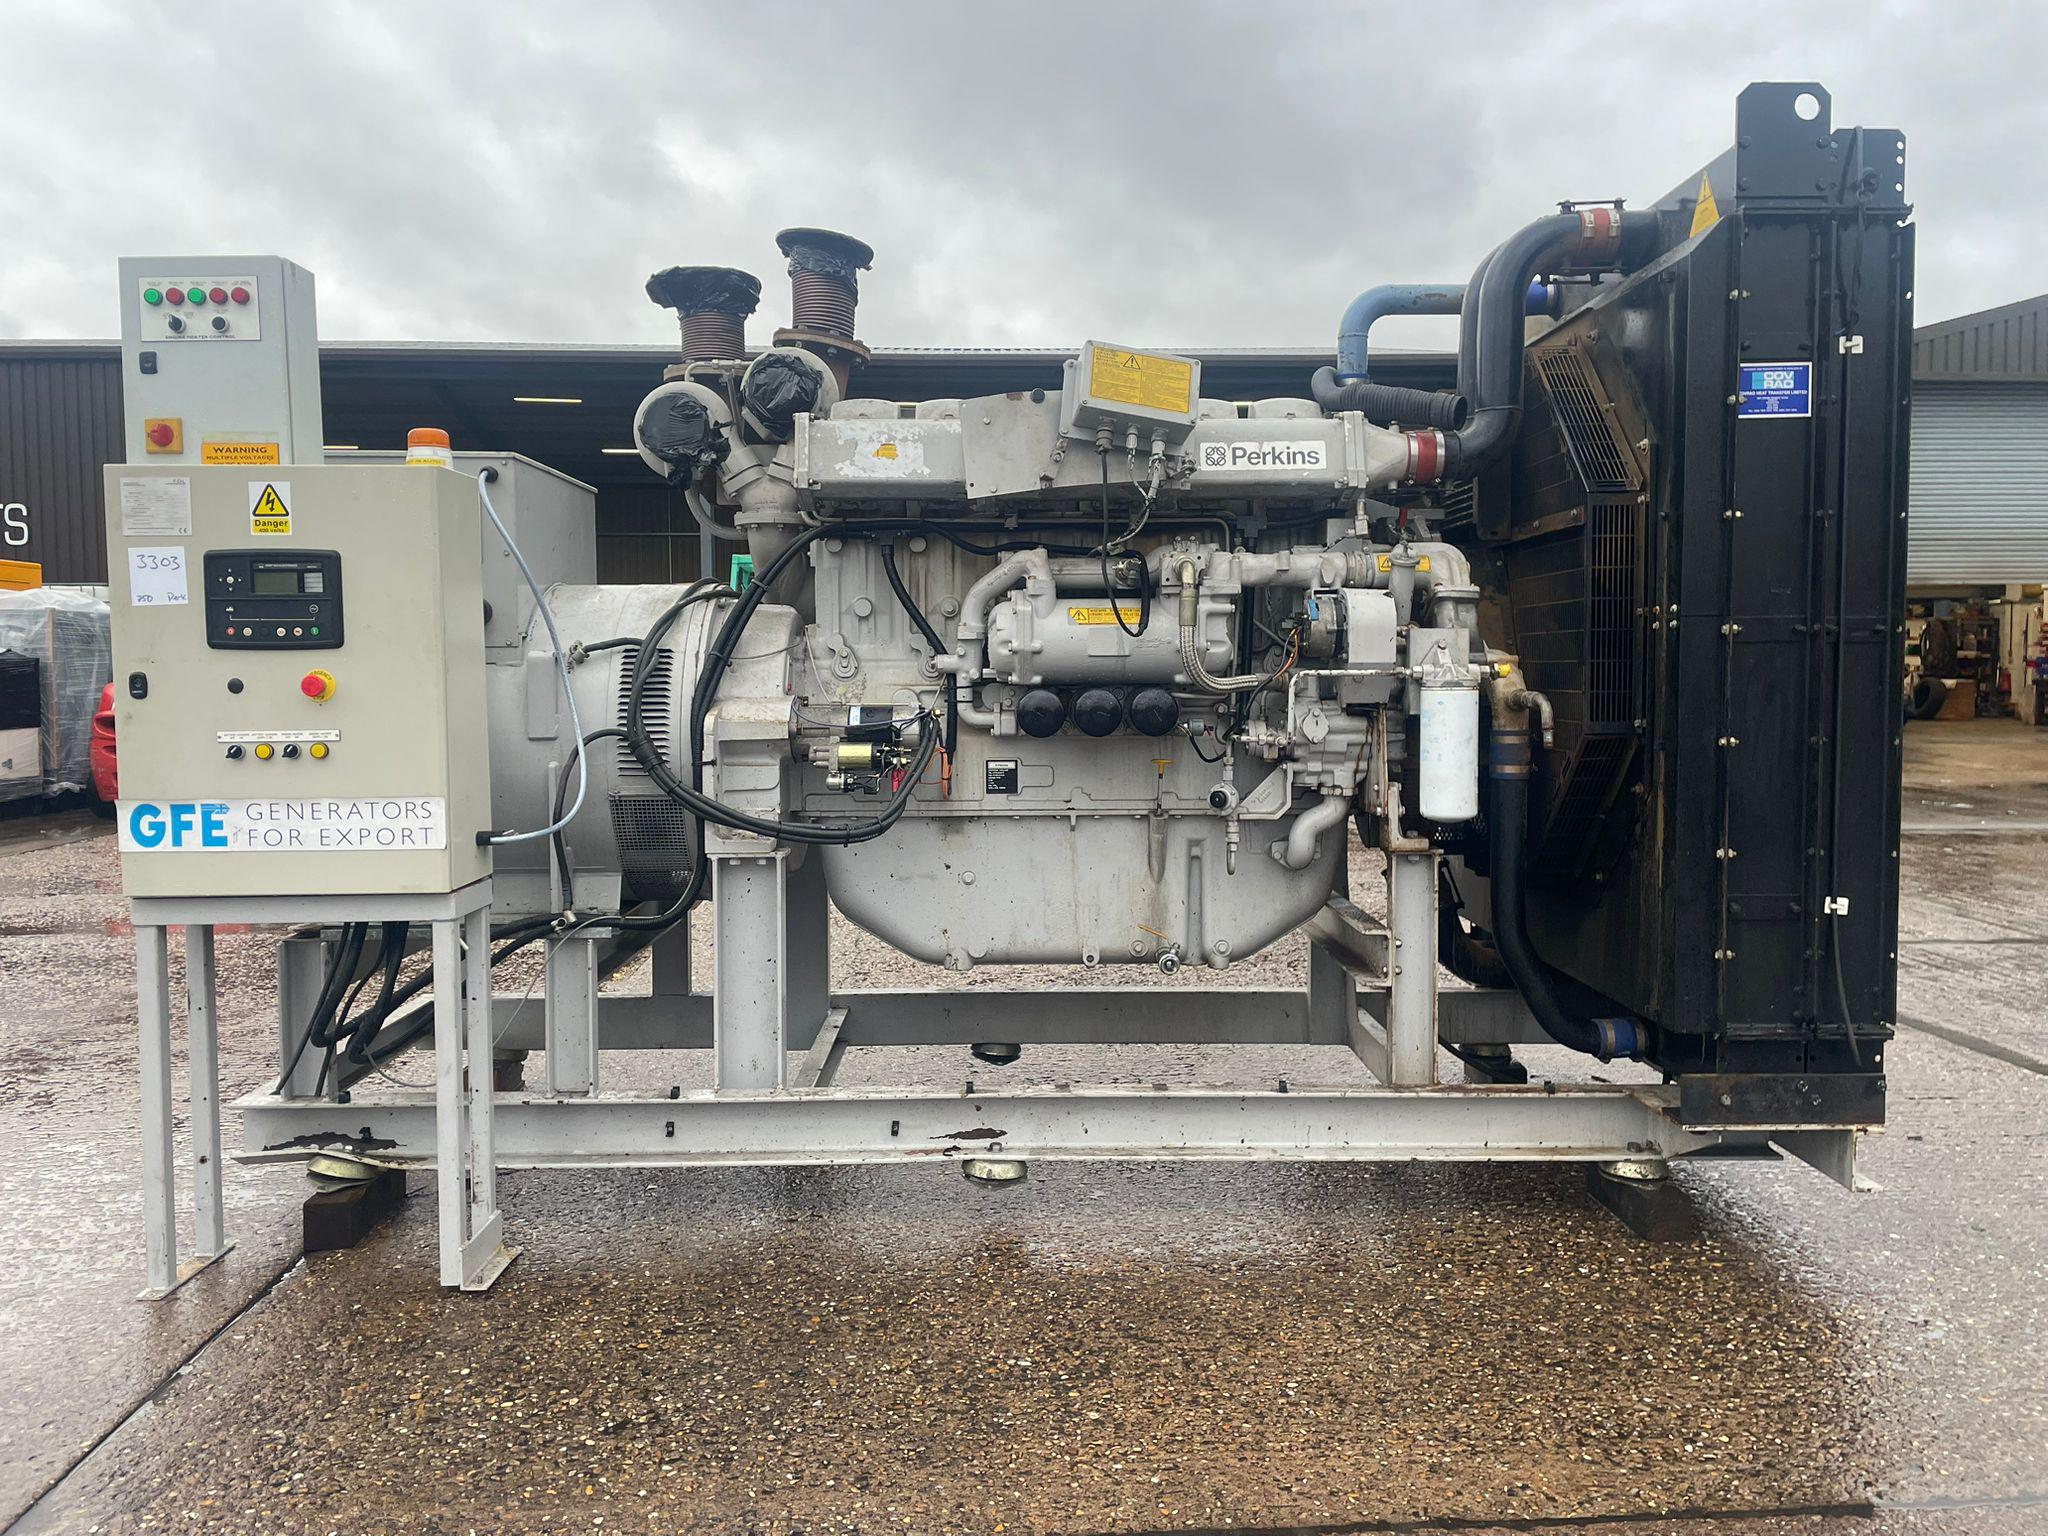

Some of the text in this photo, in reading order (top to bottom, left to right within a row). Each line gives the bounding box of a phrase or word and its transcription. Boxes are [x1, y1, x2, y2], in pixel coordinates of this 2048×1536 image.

[1232, 446, 1320, 466] Perkins
[255, 519, 288, 528] Danger
[136, 554, 181, 571] 3303
[130, 801, 432, 848] GFE GENERATORS
[248, 827, 434, 847] FOR EXPORT
